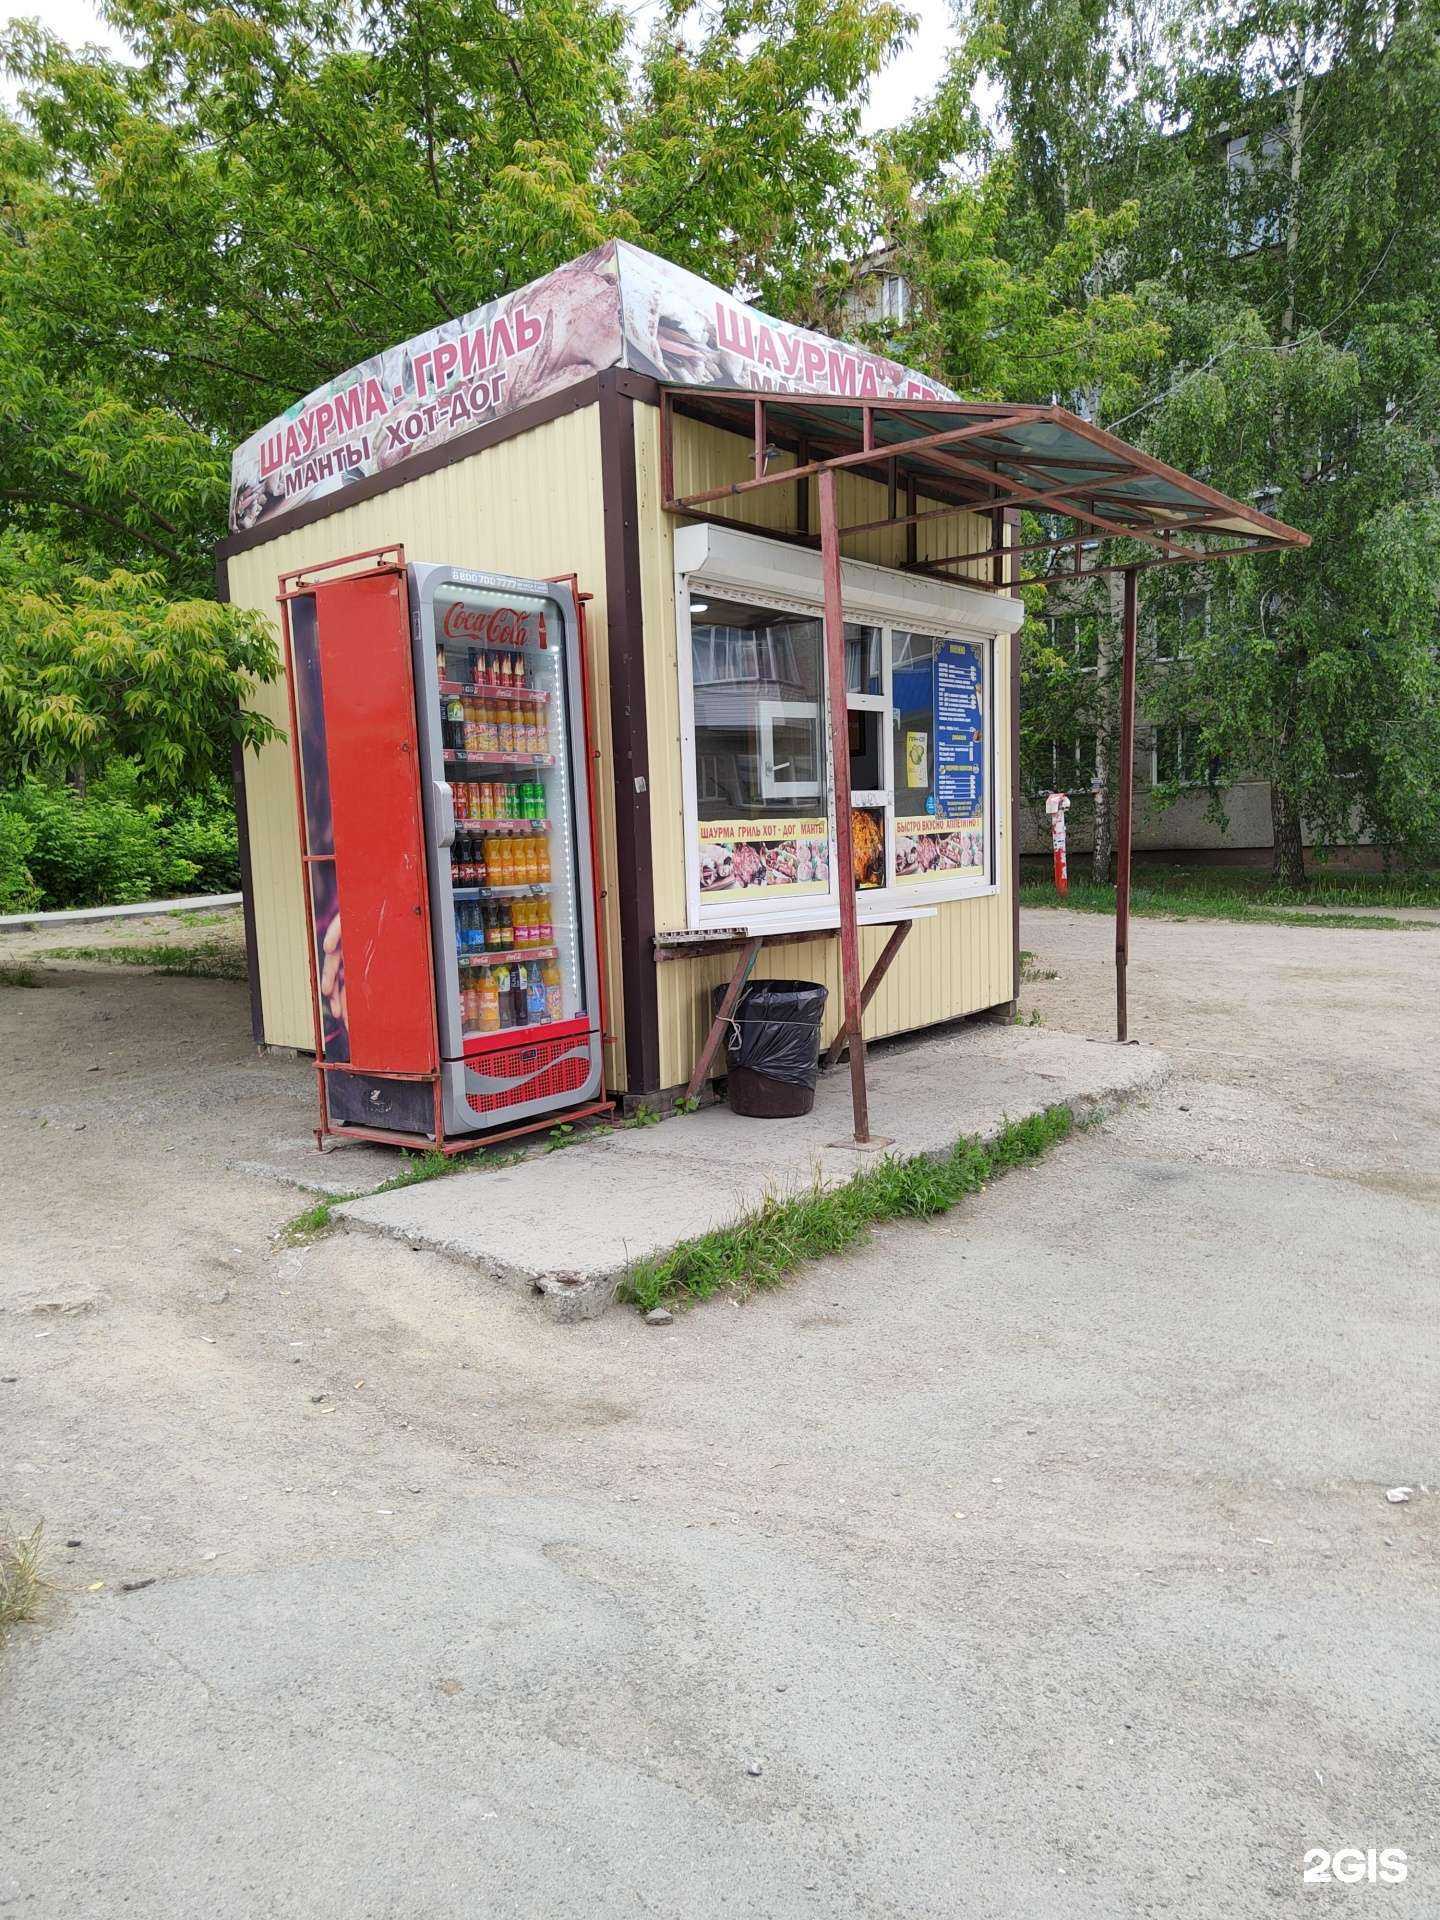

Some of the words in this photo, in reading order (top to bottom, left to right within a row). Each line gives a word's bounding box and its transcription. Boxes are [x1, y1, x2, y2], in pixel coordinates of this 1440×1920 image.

[259, 377, 389, 478] ШАУРМА
[411, 307, 544, 398] ГРИЛЬ
[715, 301, 881, 399] ШАУРМА
[285, 437, 371, 498] МАНТЫ
[387, 373, 507, 450] ХОТ-ДОГ
[700, 827, 735, 839] ШАУРМА
[738, 825, 761, 838] ГРИЛЬ
[762, 825, 777, 836] ХОТ
[783, 825, 797, 838] ДОГ
[800, 821, 825, 835] МАНТЫ
